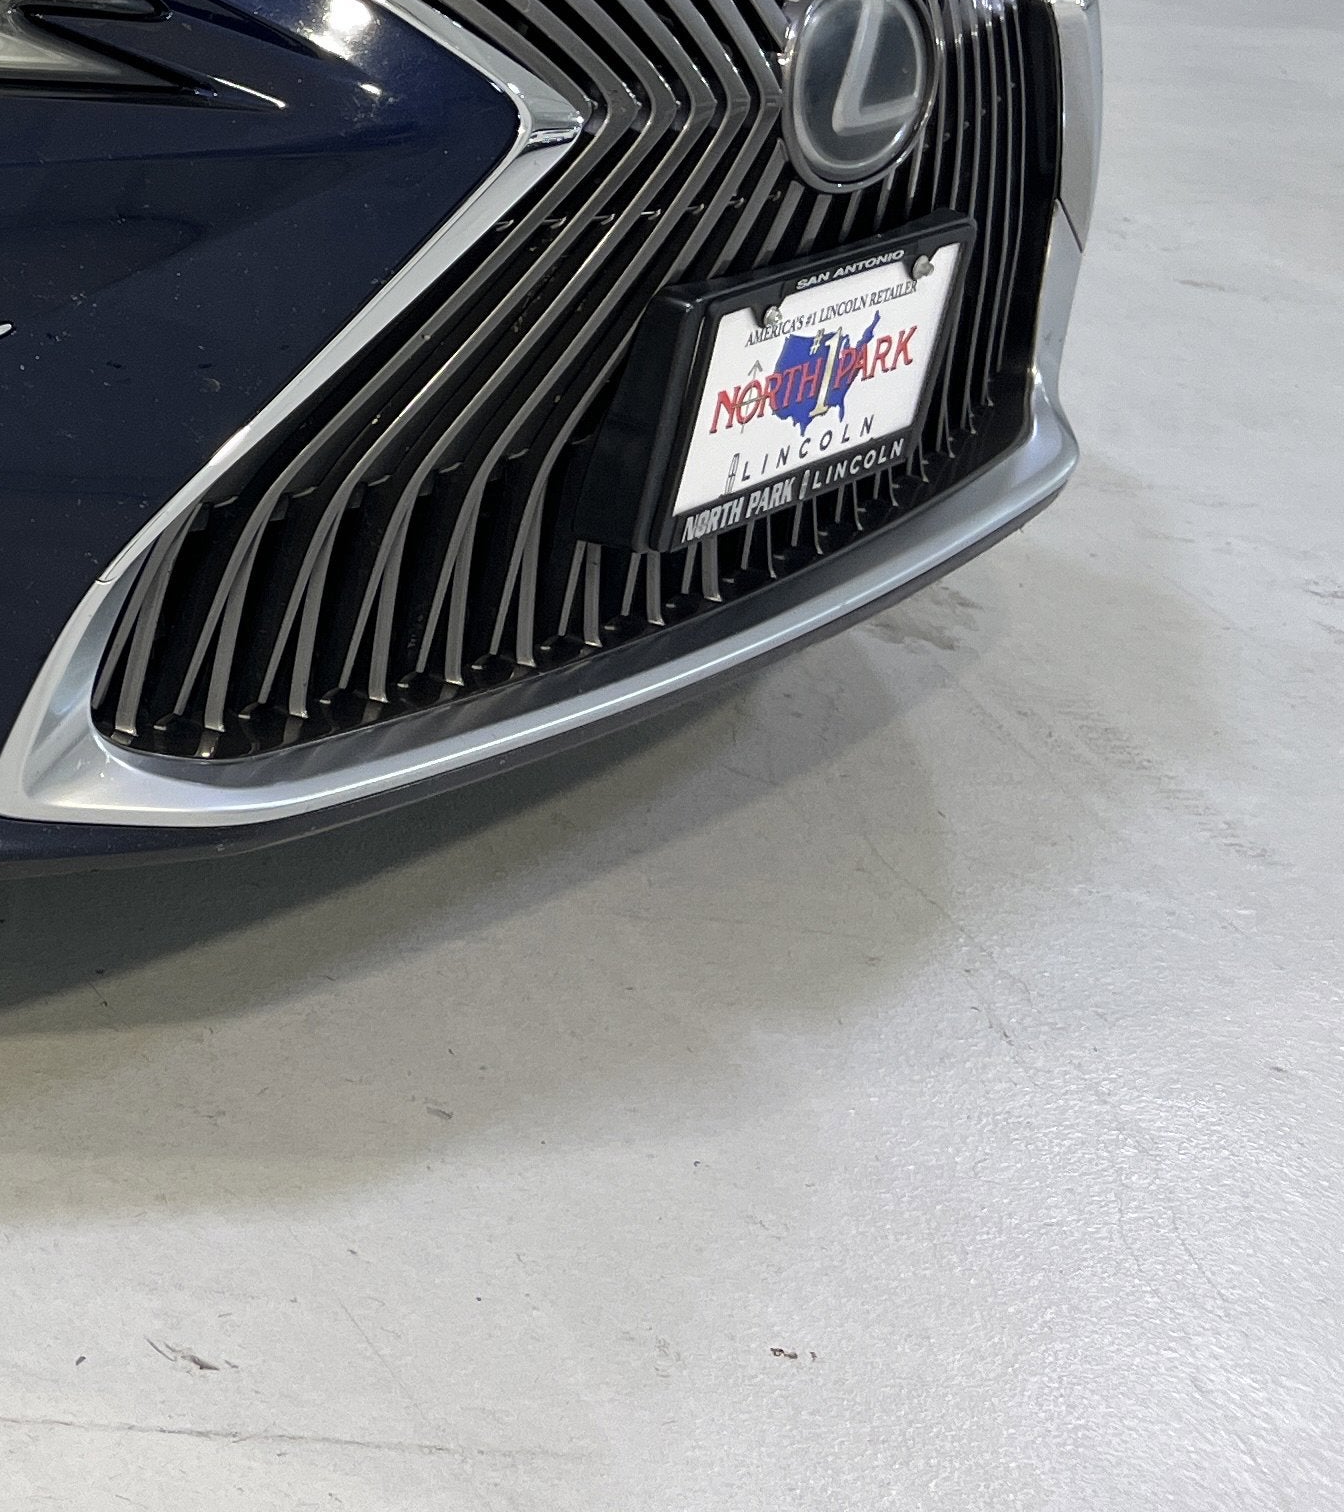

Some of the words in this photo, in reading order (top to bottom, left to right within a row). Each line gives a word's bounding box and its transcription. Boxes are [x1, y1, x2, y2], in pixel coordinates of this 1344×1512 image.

[795, 271, 830, 290] SAN
[832, 249, 905, 279] ANTONIO
[744, 312, 806, 348] AMERICA'S
[817, 294, 869, 324] LINCOLN
[868, 279, 919, 309] RETAILER
[709, 356, 824, 434] NORTH
[833, 325, 919, 389] PARK
[740, 414, 876, 482] LINCOLN
[681, 495, 745, 544] NORTH
[745, 476, 796, 519] PARK
[812, 438, 905, 490] LINCOLN
